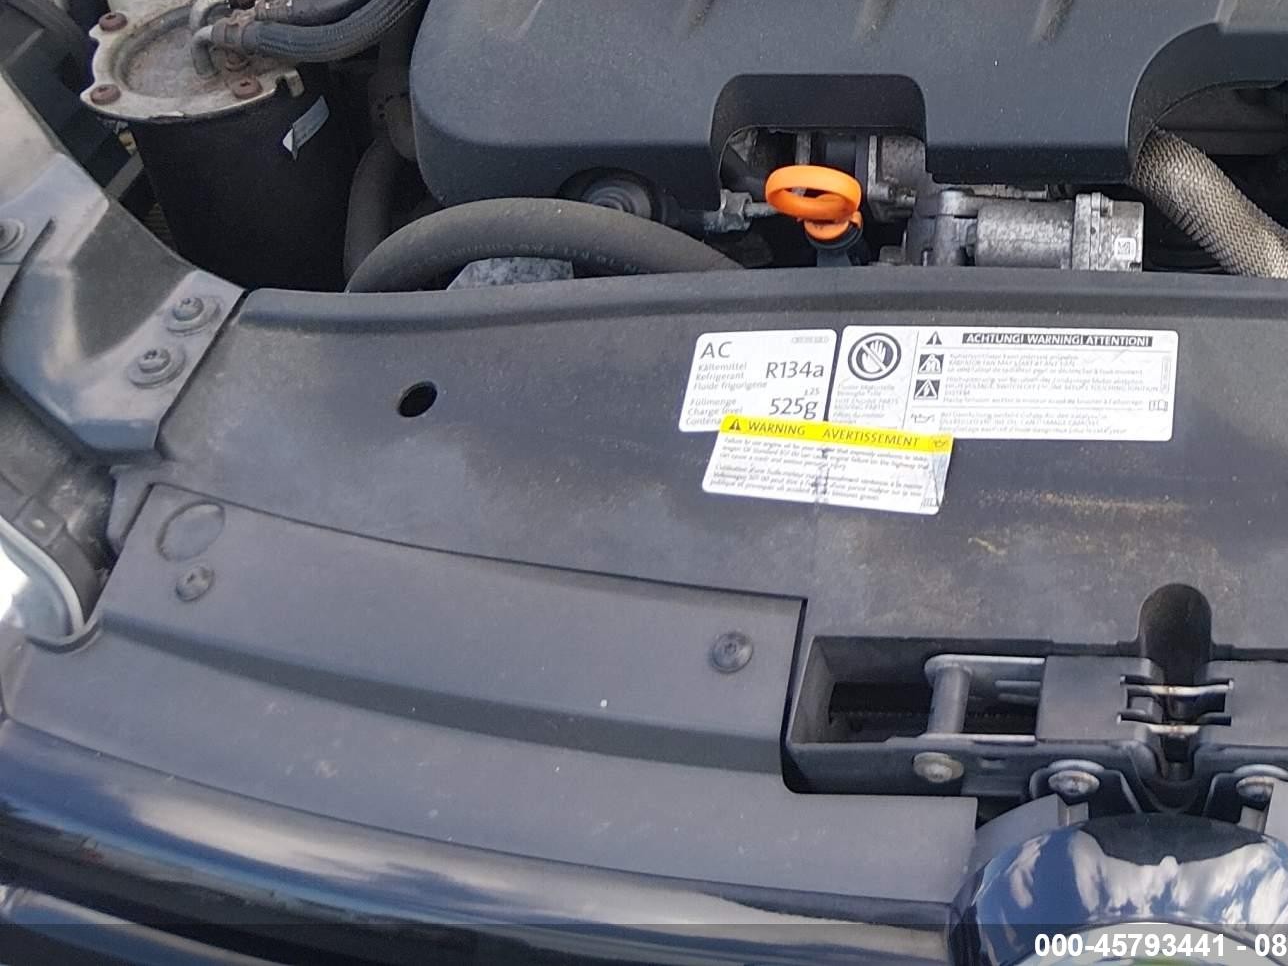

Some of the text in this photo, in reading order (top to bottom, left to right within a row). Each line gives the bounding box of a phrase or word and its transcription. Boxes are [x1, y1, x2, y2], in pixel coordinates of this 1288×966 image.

[700, 341, 732, 359] AC
[765, 360, 825, 379] R134a
[769, 397, 818, 420] 525g
[748, 421, 806, 435] WARNING
[822, 429, 920, 446] AVERTISSEMENT
